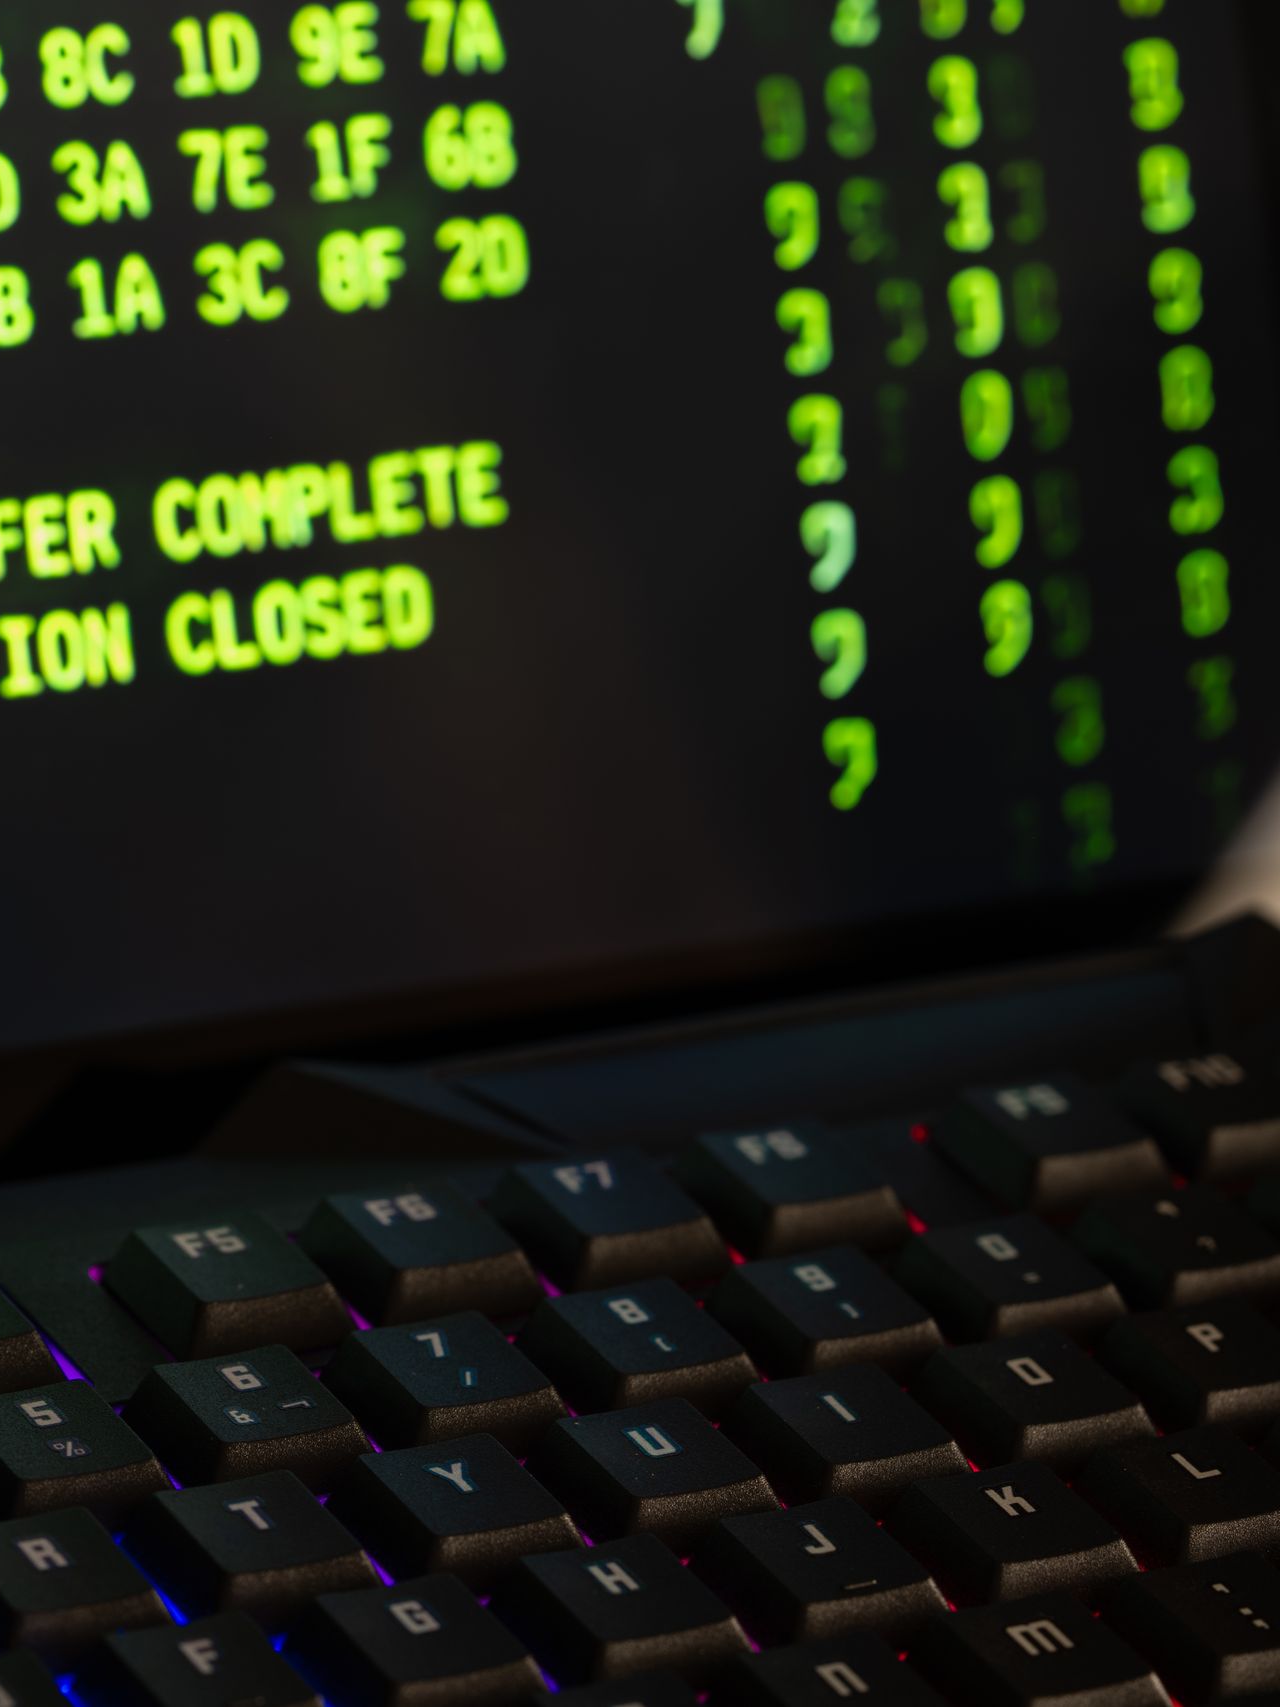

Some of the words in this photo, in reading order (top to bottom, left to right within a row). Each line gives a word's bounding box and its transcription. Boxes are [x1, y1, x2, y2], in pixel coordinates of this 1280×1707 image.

[39, 23, 134, 109] 8C
[171, 12, 261, 98] 1D
[289, 1, 384, 88] 9E
[407, 0, 505, 75] 7A
[51, 140, 151, 225] 3A
[178, 125, 274, 212] 7E
[306, 113, 391, 203] 1F
[69, 253, 165, 338] 1A
[194, 239, 289, 326] 3C
[152, 441, 508, 563] COMPLETE
[165, 564, 434, 675] CLOSED
[553, 1161, 613, 1194] F7
[172, 1226, 246, 1259] F5
[415, 1331, 445, 1358] 7
[1186, 1323, 1223, 1353] P
[220, 1364, 262, 1390] 6
[19, 1399, 63, 1427] 5
[52, 1440, 86, 1457] %
[626, 1426, 677, 1457] U
[428, 1462, 473, 1492] Y
[1170, 1452, 1222, 1480] L
[228, 1499, 269, 1530] T
[984, 1485, 1036, 1517] K
[17, 1537, 68, 1571] R
[803, 1523, 837, 1555] J
[588, 1561, 639, 1595] H
[389, 1600, 440, 1634] G
[179, 1638, 217, 1674] F
